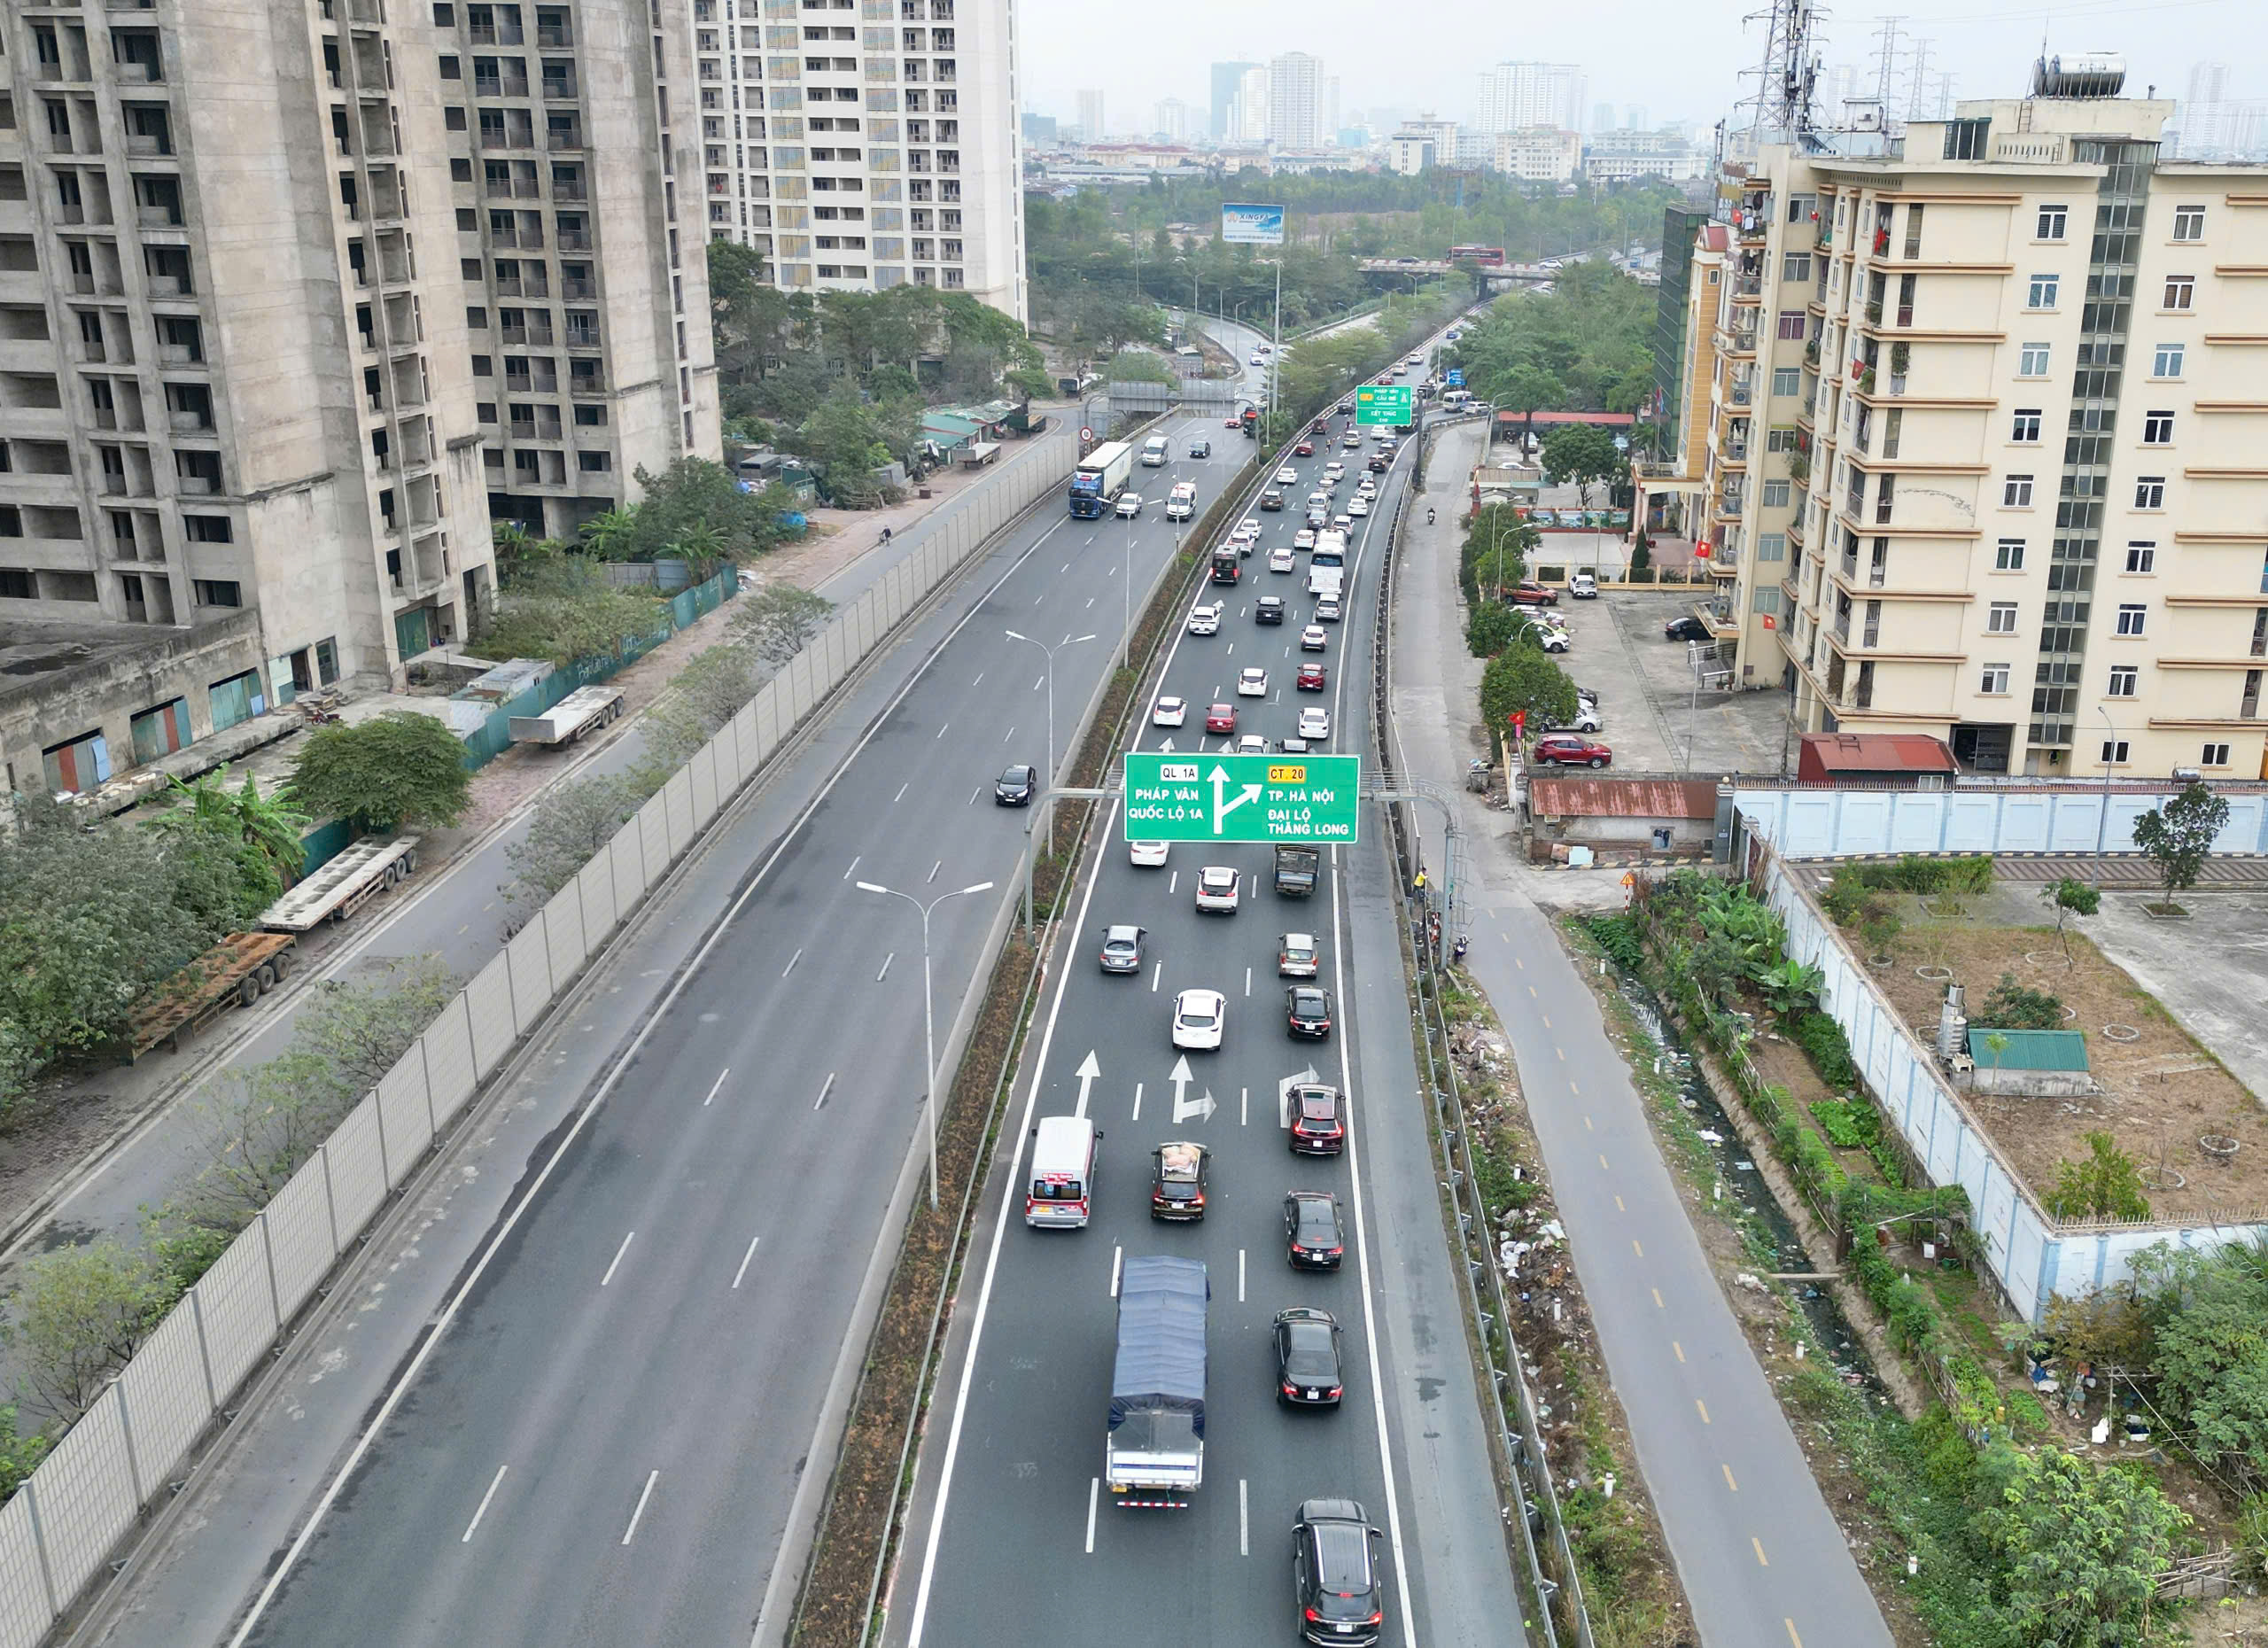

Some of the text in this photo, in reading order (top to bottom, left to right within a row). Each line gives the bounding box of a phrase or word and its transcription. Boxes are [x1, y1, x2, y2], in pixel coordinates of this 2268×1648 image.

[1135, 787, 1199, 801] PHÁP VÂN
[1311, 788, 1334, 805] NỘI
[1129, 804, 1203, 822] QUỐC LỘ 1A
[1268, 806, 1311, 824] ĐẠI LỘ
[1268, 821, 1349, 836] THĂNG LONG
